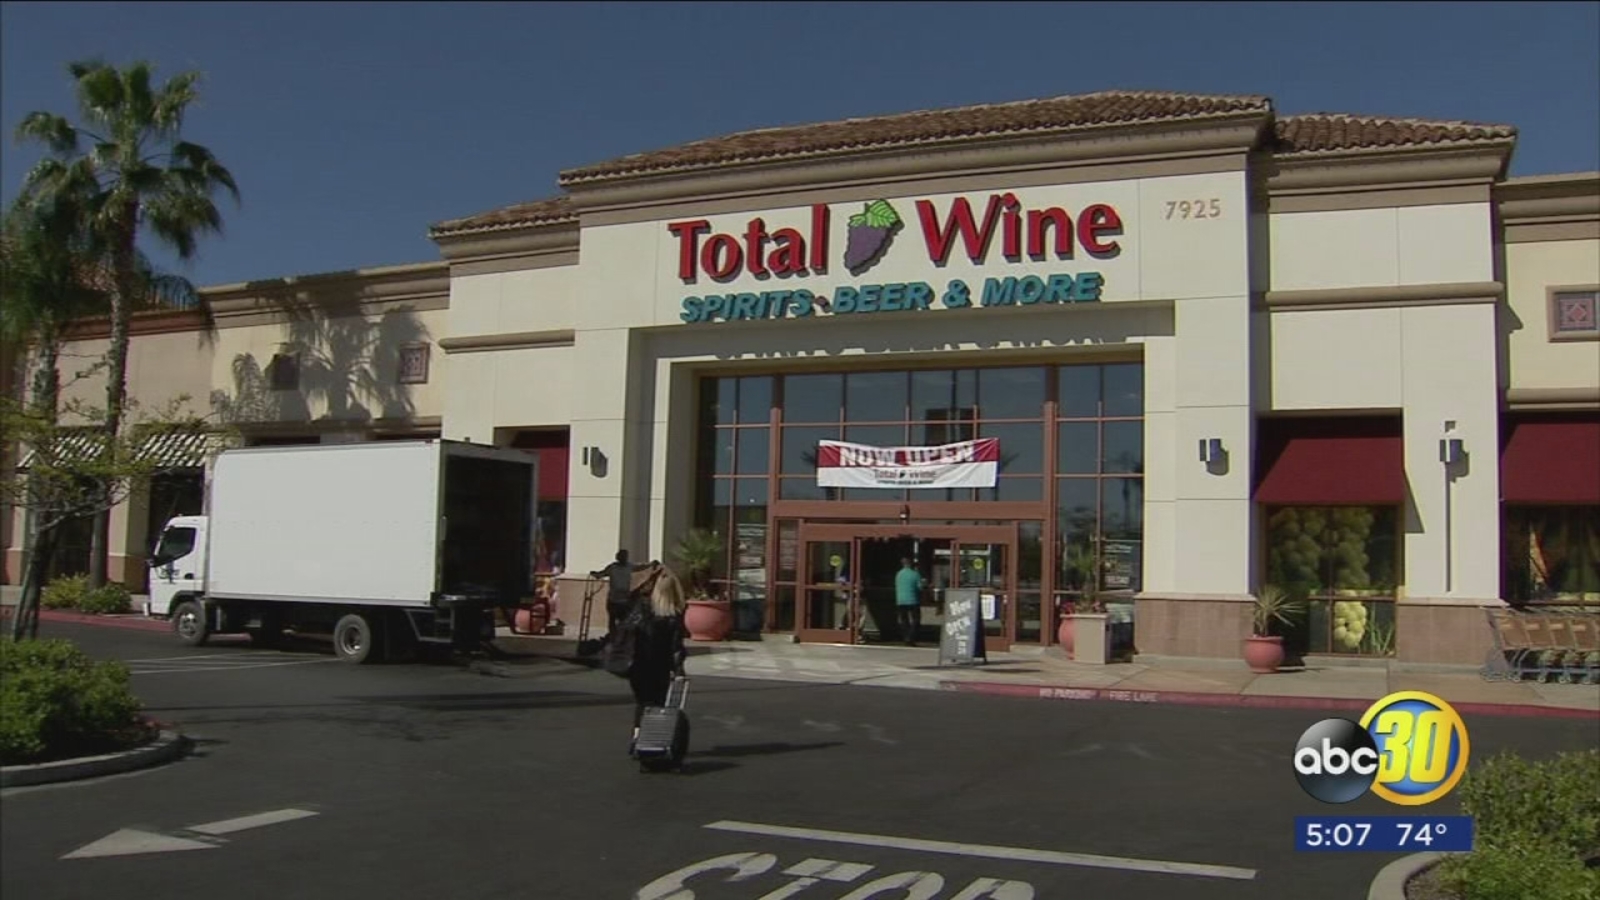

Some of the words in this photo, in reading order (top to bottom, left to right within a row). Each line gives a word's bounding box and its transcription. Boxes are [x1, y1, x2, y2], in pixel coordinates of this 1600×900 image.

[1165, 198, 1221, 220] 7925
[667, 202, 831, 284] Total
[914, 191, 1124, 268] Wine
[679, 288, 814, 324] SPIRITS
[831, 281, 935, 314] BEER
[942, 278, 973, 308] &
[980, 271, 1105, 306] MORE
[839, 447, 897, 467] NOW
